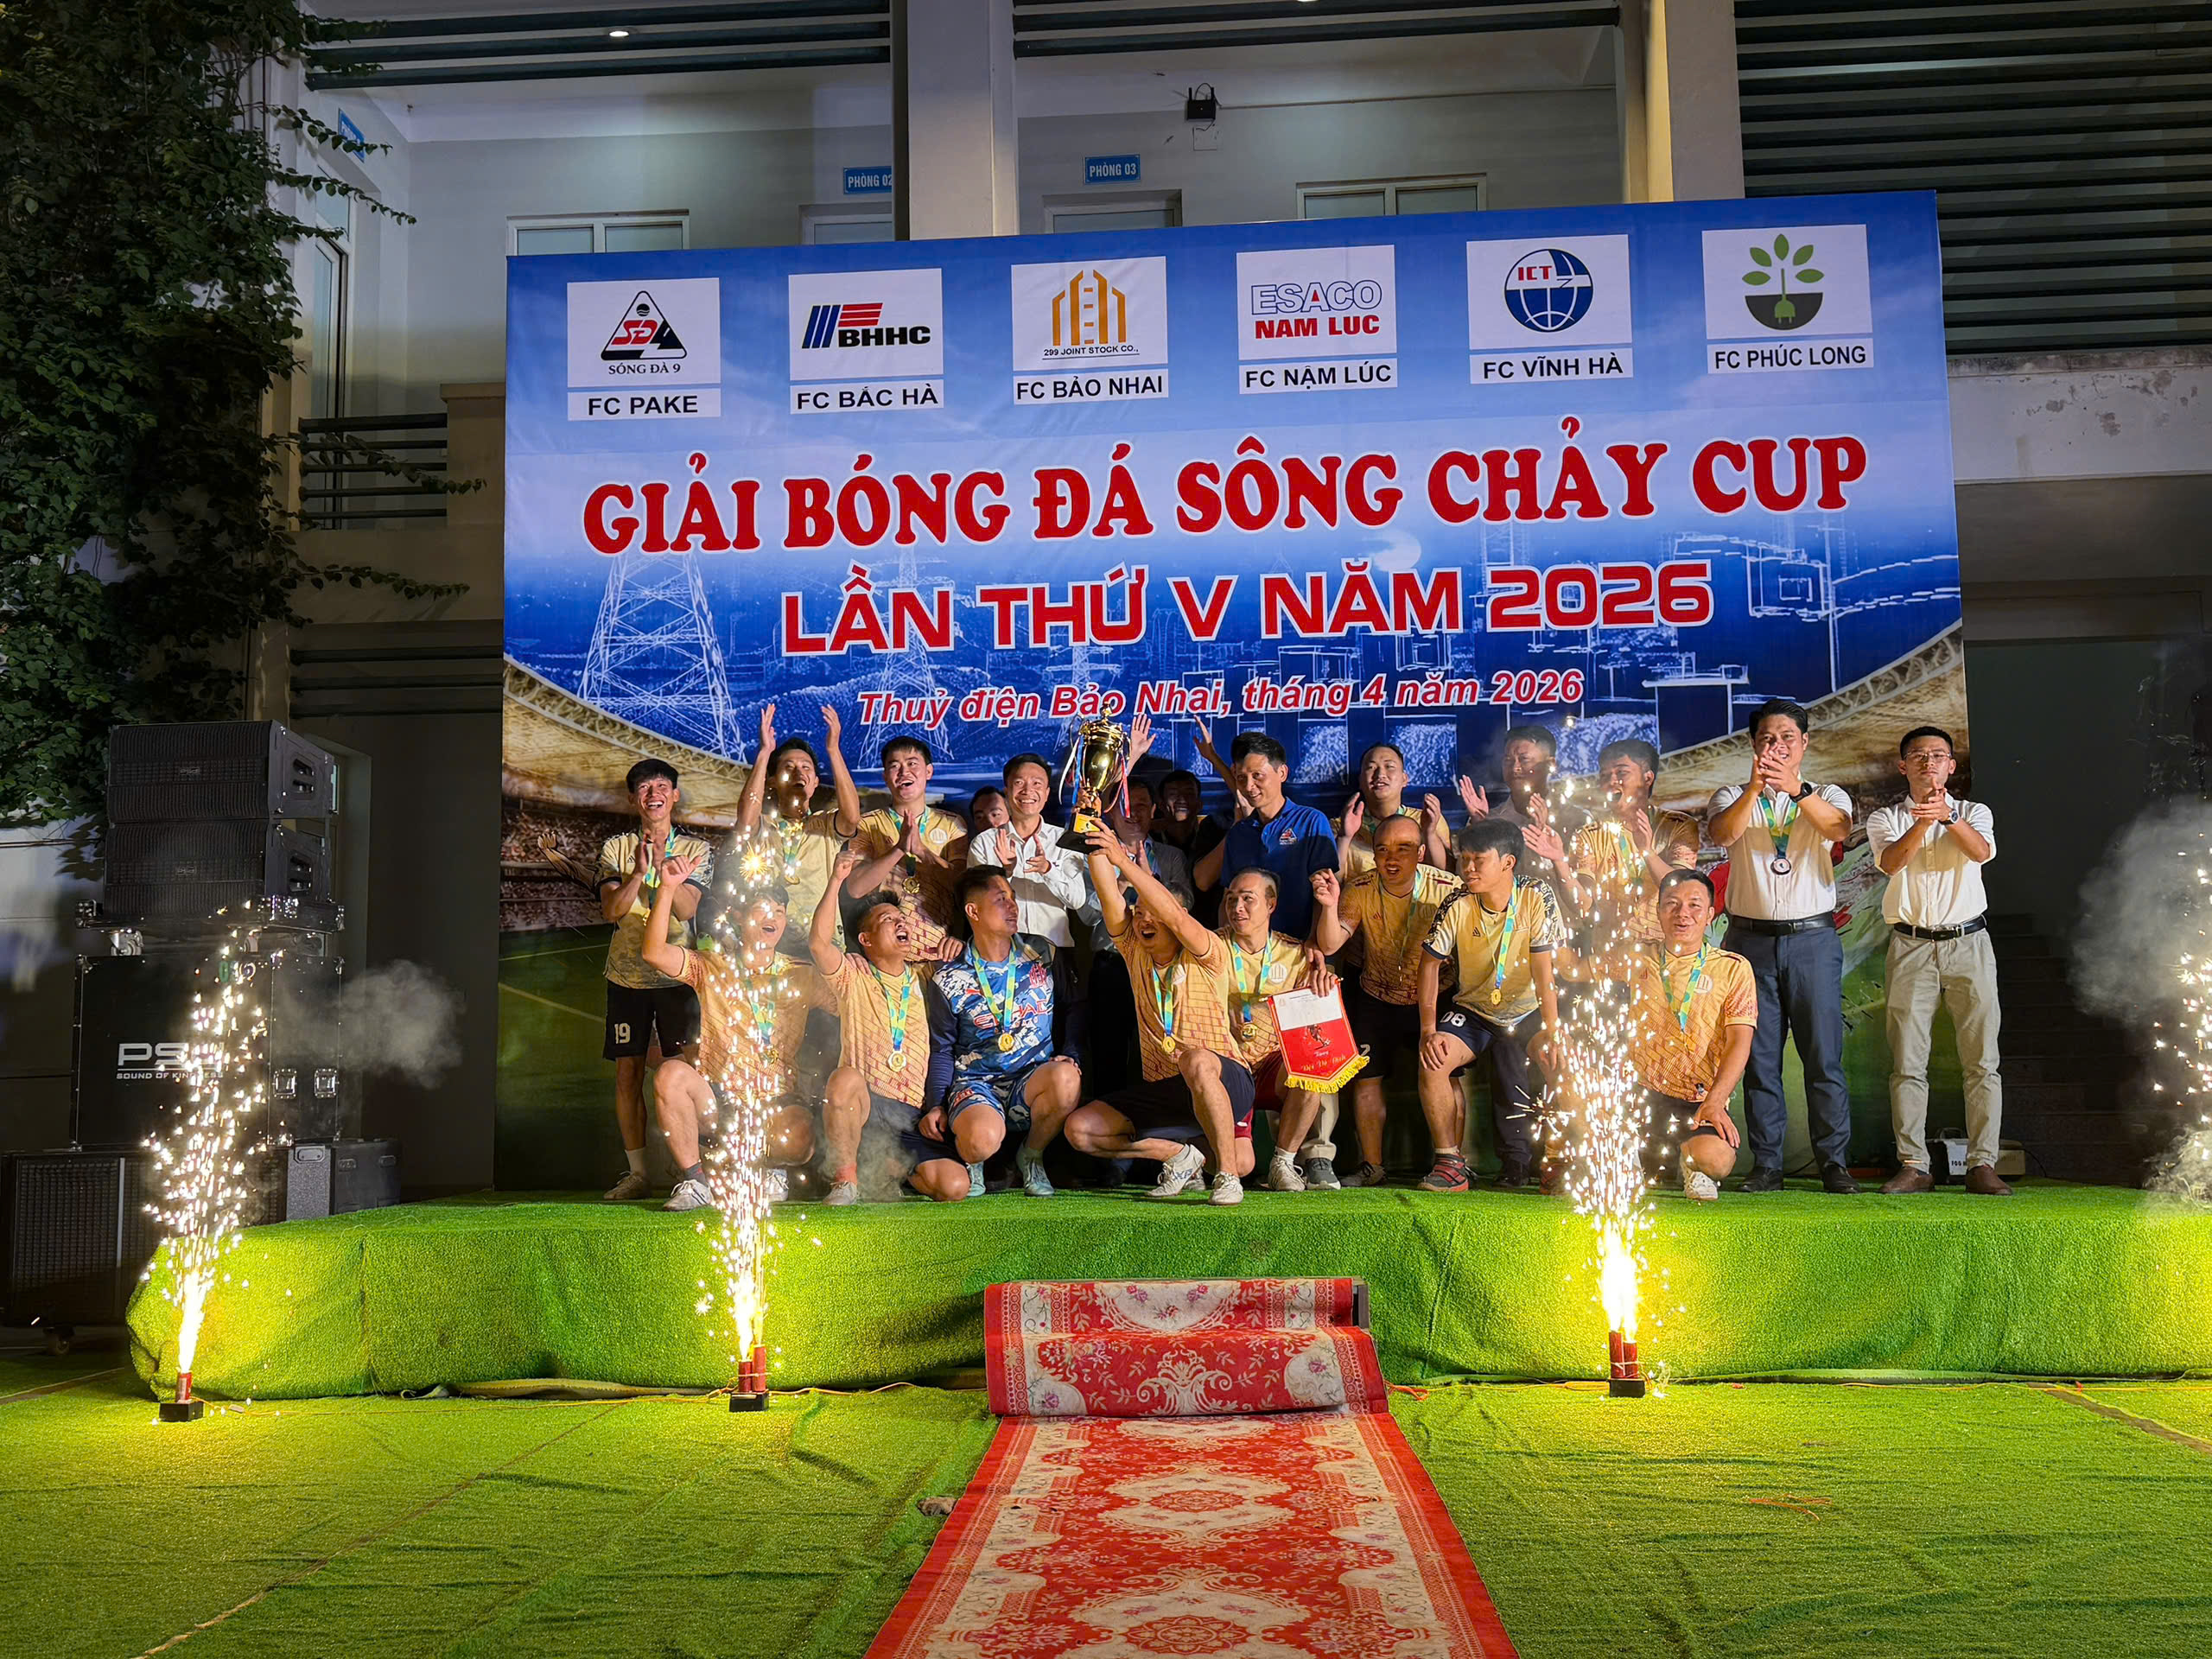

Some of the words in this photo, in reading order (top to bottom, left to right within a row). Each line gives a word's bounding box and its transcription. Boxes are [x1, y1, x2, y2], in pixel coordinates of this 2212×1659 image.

[848, 173, 880, 188] PHÒNG
[1090, 162, 1122, 177] PHÒNG
[1124, 163, 1137, 175] 03
[1518, 265, 1553, 281] ICT
[1251, 279, 1382, 315] ESACO
[838, 326, 931, 347] BHHC
[1255, 317, 1319, 340] NAM
[1328, 315, 1380, 336] LUC
[1089, 346, 1118, 354] STOCK
[1715, 351, 1740, 369] FC
[1746, 344, 1803, 368] PHÚC
[1809, 346, 1866, 365] LONG
[650, 361, 669, 373] ĐÀ
[672, 363, 681, 373] 9
[1245, 370, 1275, 388] FC
[1283, 365, 1337, 390] NẬM
[1344, 361, 1392, 384] LÚC
[1484, 361, 1515, 378] FC
[1522, 355, 1580, 378] VĨNH
[1588, 352, 1624, 375] HÀ
[798, 391, 830, 410] FC
[902, 383, 939, 405] HÀ
[1017, 382, 1046, 400] FC
[1053, 376, 1102, 398] BẢO
[1109, 376, 1163, 396] NHAI
[588, 397, 621, 416] FC
[629, 395, 698, 415] PAKE
[583, 452, 762, 556] GIẢI
[783, 454, 1014, 550] BÓNG
[1031, 442, 1155, 541] ĐÁ
[1174, 435, 1405, 535] SÔNG
[1427, 416, 1669, 525] CHẢY
[1691, 436, 1868, 515] CUP
[785, 563, 952, 653] LẦN
[979, 567, 1147, 647] THỨ
[1172, 578, 1236, 639] V
[1262, 560, 1462, 636] NĂM
[1488, 563, 1712, 630] 2026
[859, 690, 951, 729] Thuỷ
[961, 688, 1039, 727] điện
[1052, 683, 1125, 717] Bảo
[1136, 680, 1230, 717] Nhai,
[1244, 677, 1351, 715] tháng
[1363, 674, 1385, 706] 4
[1395, 672, 1479, 705] năm
[1491, 670, 1585, 703] 2026
[1440, 1011, 1466, 1027] 08
[614, 1023, 631, 1044] 19
